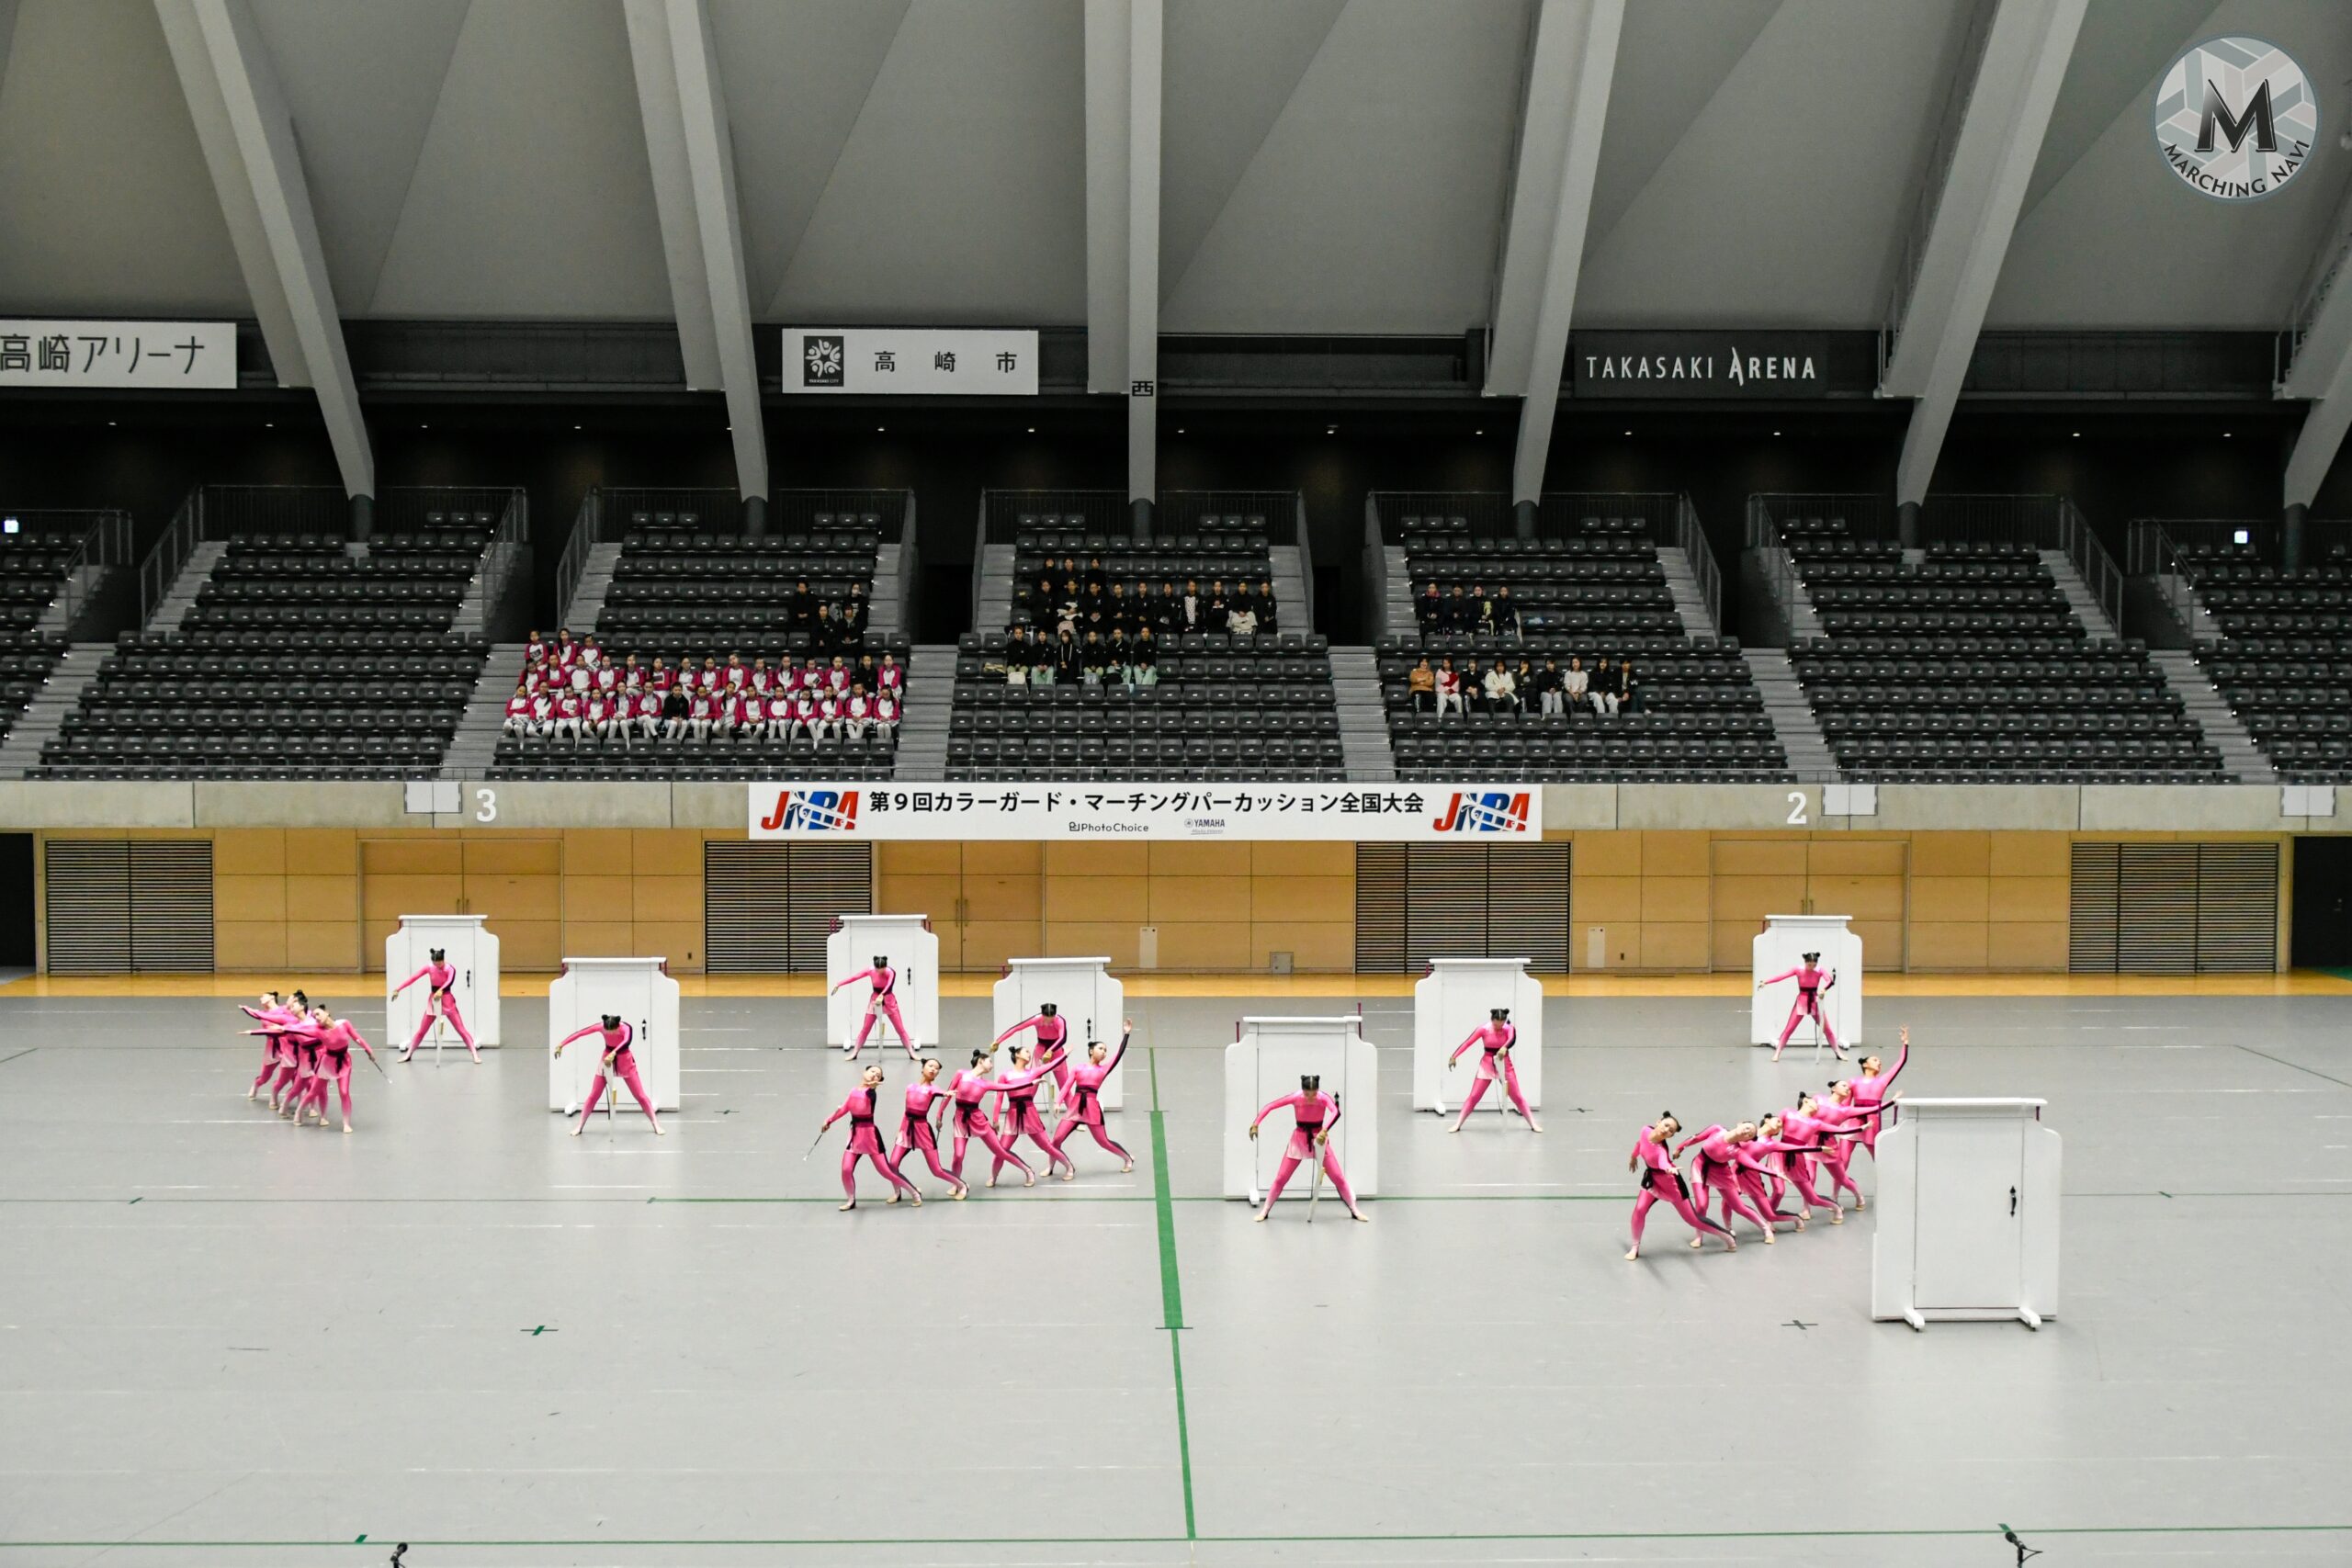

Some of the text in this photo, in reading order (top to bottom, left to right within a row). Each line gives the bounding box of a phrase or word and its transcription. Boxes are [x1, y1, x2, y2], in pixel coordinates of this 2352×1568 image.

[0, 333, 205, 374] 高崎アリーナ
[1586, 346, 1815, 386] TAKASAKI ARENA
[1132, 380, 1154, 397] 西
[476, 788, 497, 822] 3
[1787, 792, 1807, 824] 2
[1194, 818, 1226, 828] YAMAHA
